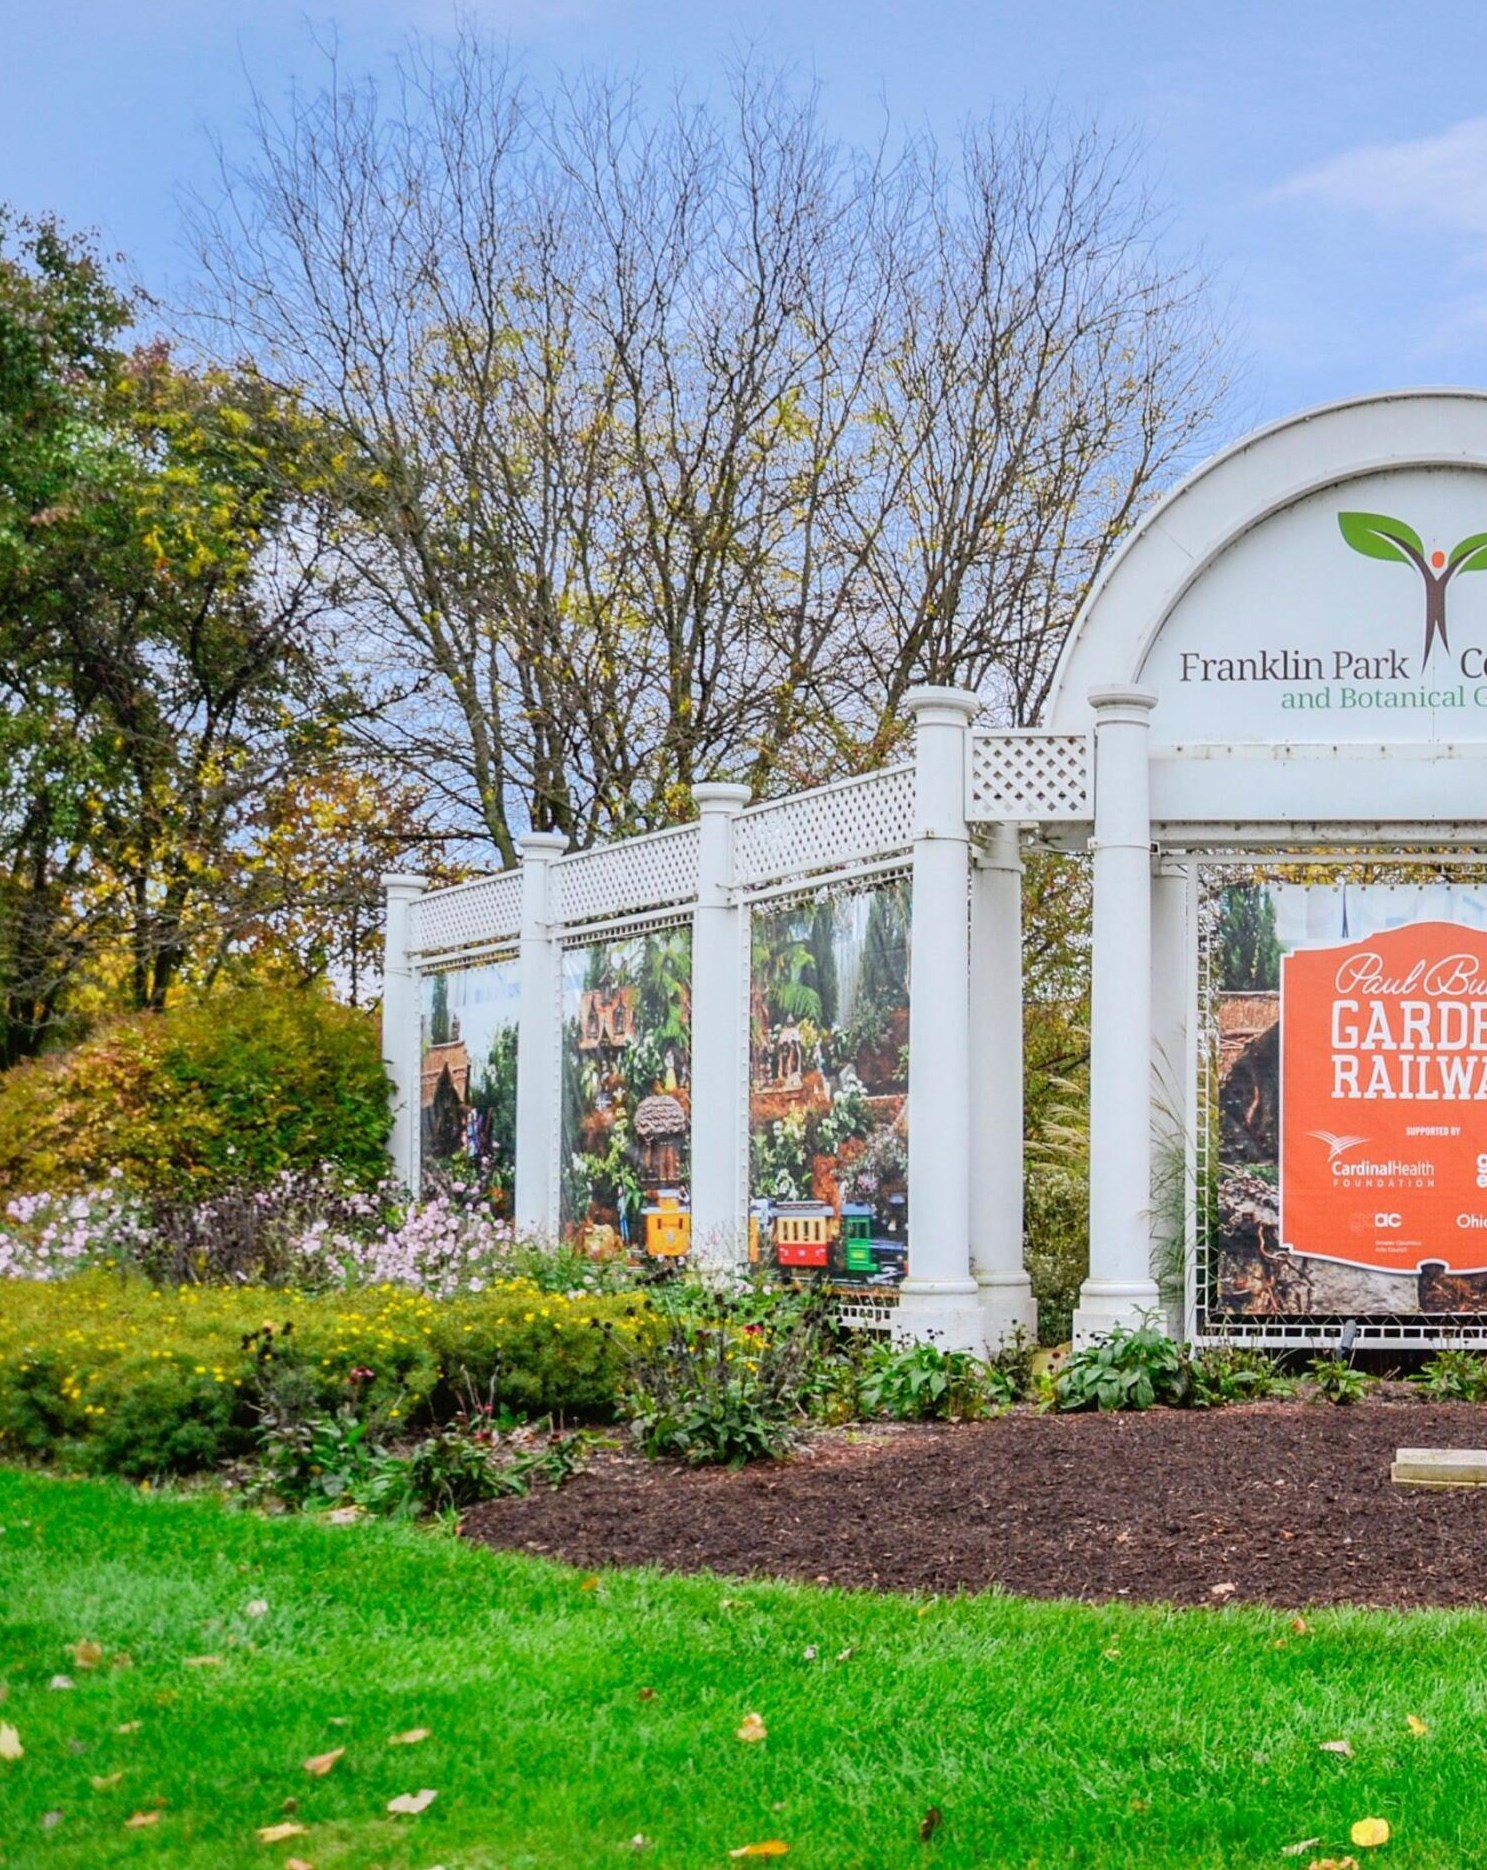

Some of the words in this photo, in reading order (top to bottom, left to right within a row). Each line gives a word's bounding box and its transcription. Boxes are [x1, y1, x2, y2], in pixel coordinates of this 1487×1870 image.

[1179, 650, 1325, 682] Franklin
[1332, 649, 1410, 681] Park
[1281, 686, 1331, 710] and
[1340, 684, 1466, 709] Botanical
[1335, 952, 1426, 995] Paul
[1405, 1126, 1450, 1136] SUPPORTED
[1450, 1126, 1461, 1136] BY
[1333, 1178, 1435, 1188] FOUNDATION
